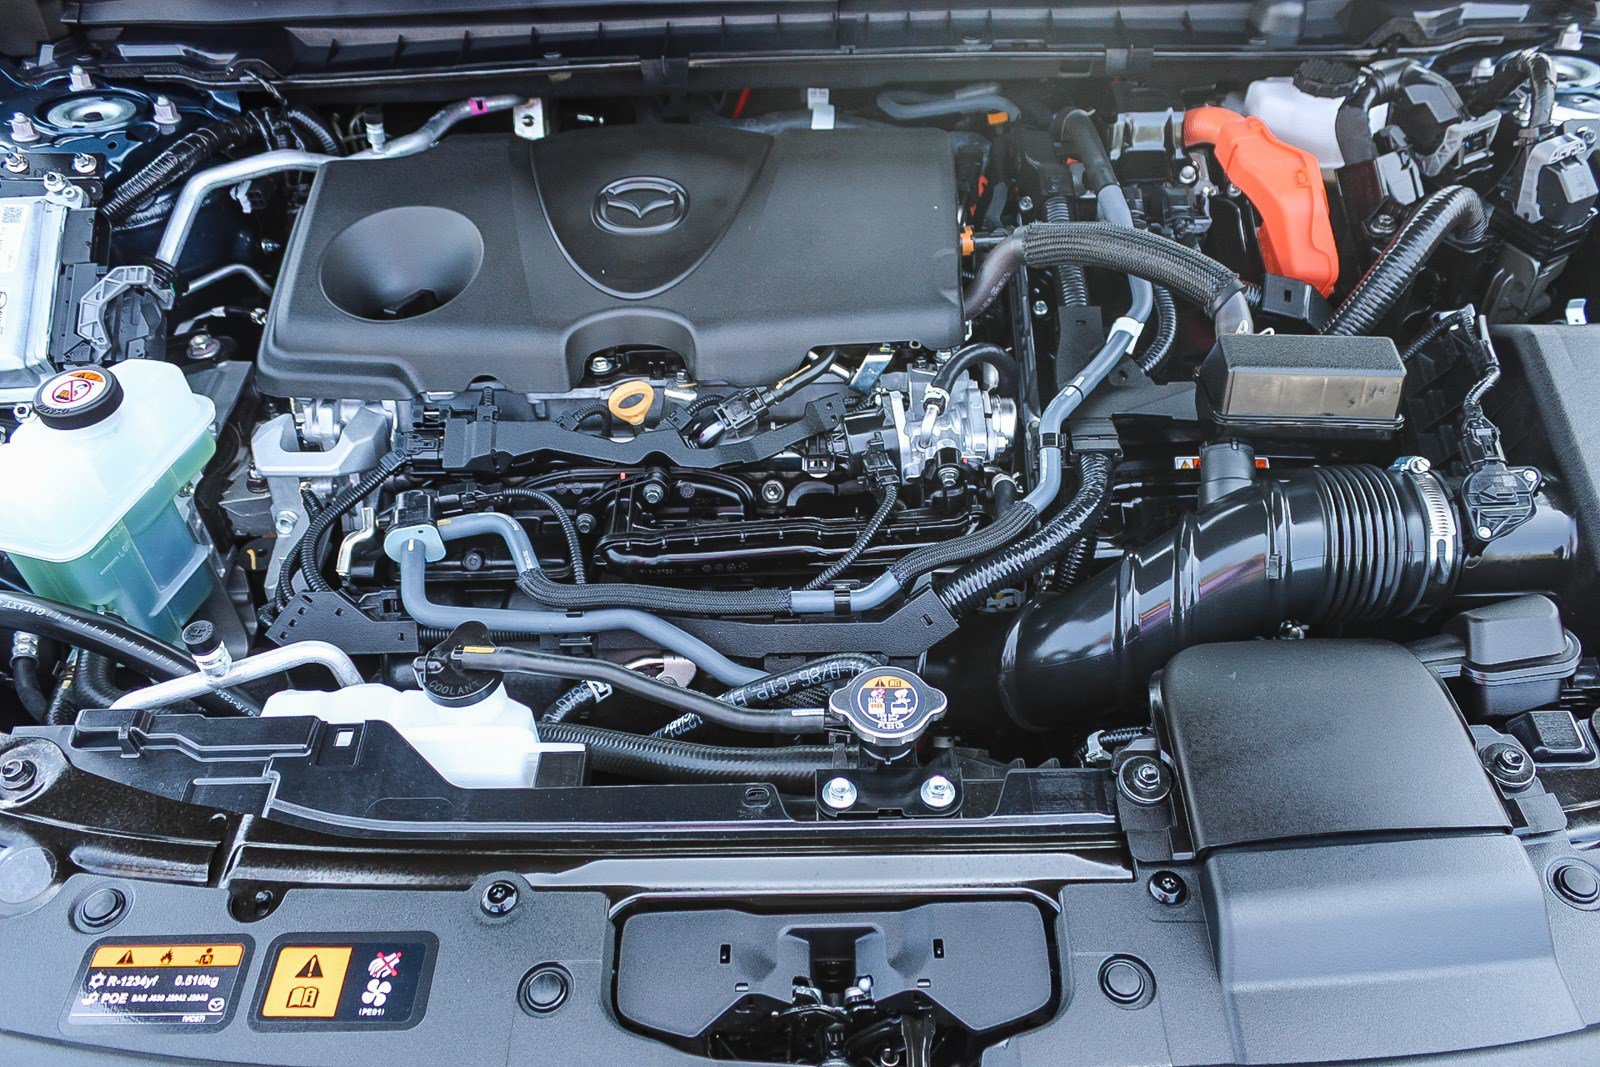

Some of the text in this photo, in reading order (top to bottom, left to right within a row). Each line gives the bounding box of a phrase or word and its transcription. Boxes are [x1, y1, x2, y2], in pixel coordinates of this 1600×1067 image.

[2, 599, 46, 616] GALAXY
[429, 680, 481, 695] COOLANT
[106, 974, 160, 989] R-1234yf
[100, 992, 129, 1005] POE
